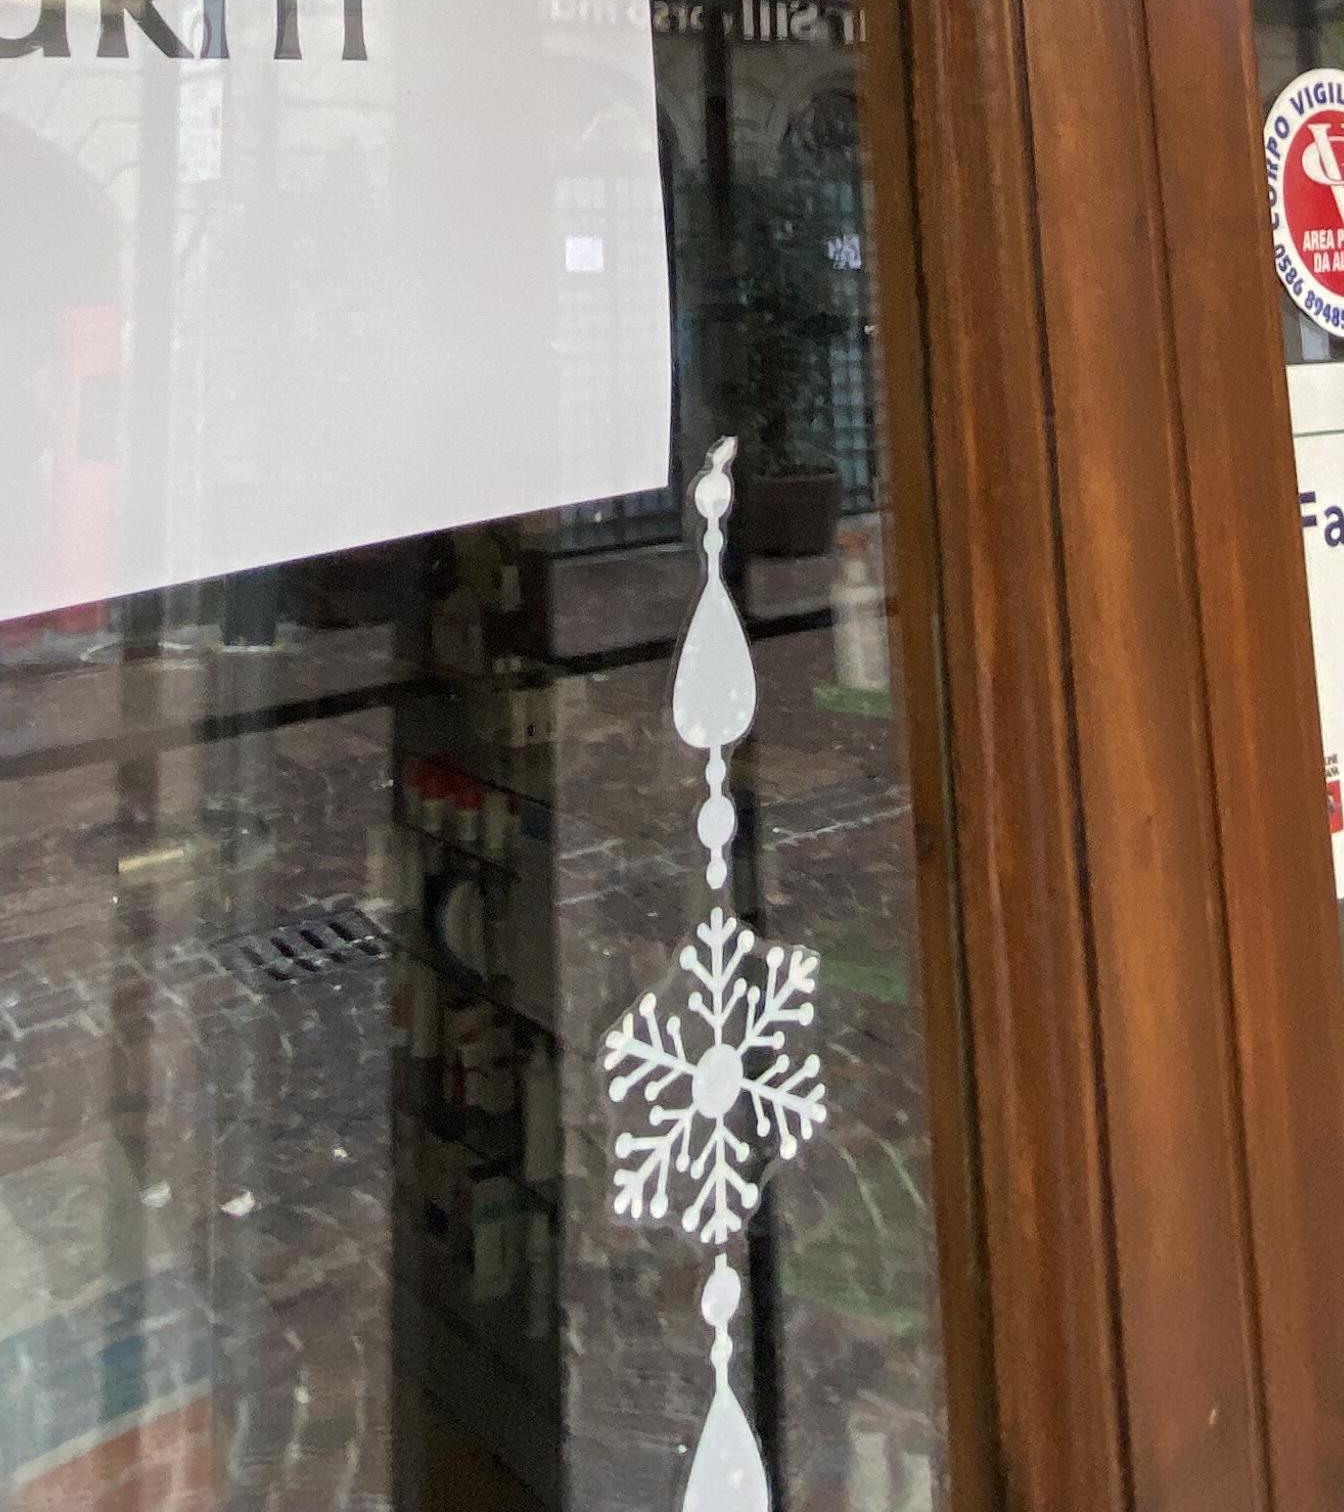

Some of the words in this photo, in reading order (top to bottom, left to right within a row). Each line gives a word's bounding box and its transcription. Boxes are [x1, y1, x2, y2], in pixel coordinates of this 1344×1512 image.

[1302, 229, 1335, 252] AREA
[1274, 243, 1305, 296] 0586
[1313, 252, 1331, 274] DA
